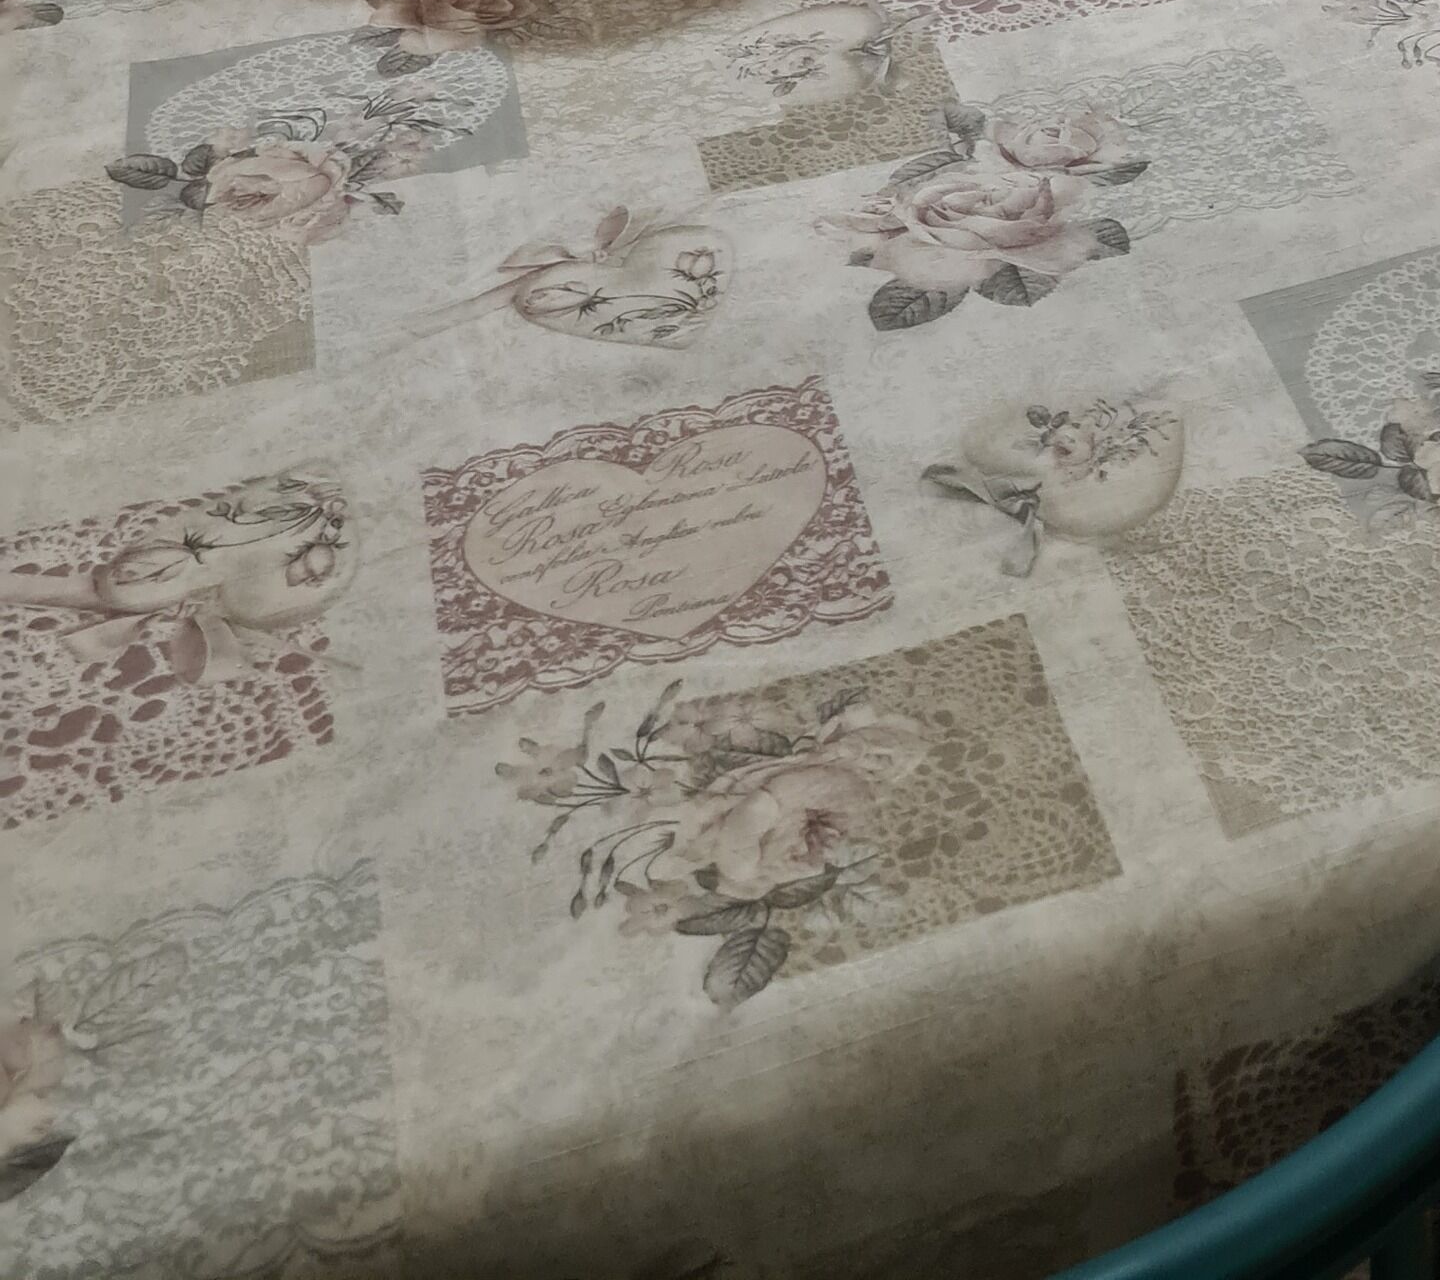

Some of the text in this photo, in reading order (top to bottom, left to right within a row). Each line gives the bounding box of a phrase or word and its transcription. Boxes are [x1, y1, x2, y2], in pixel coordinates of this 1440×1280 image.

[647, 441, 752, 484] Rosa
[490, 515, 602, 566] Rosa
[551, 559, 692, 610] Rosa
